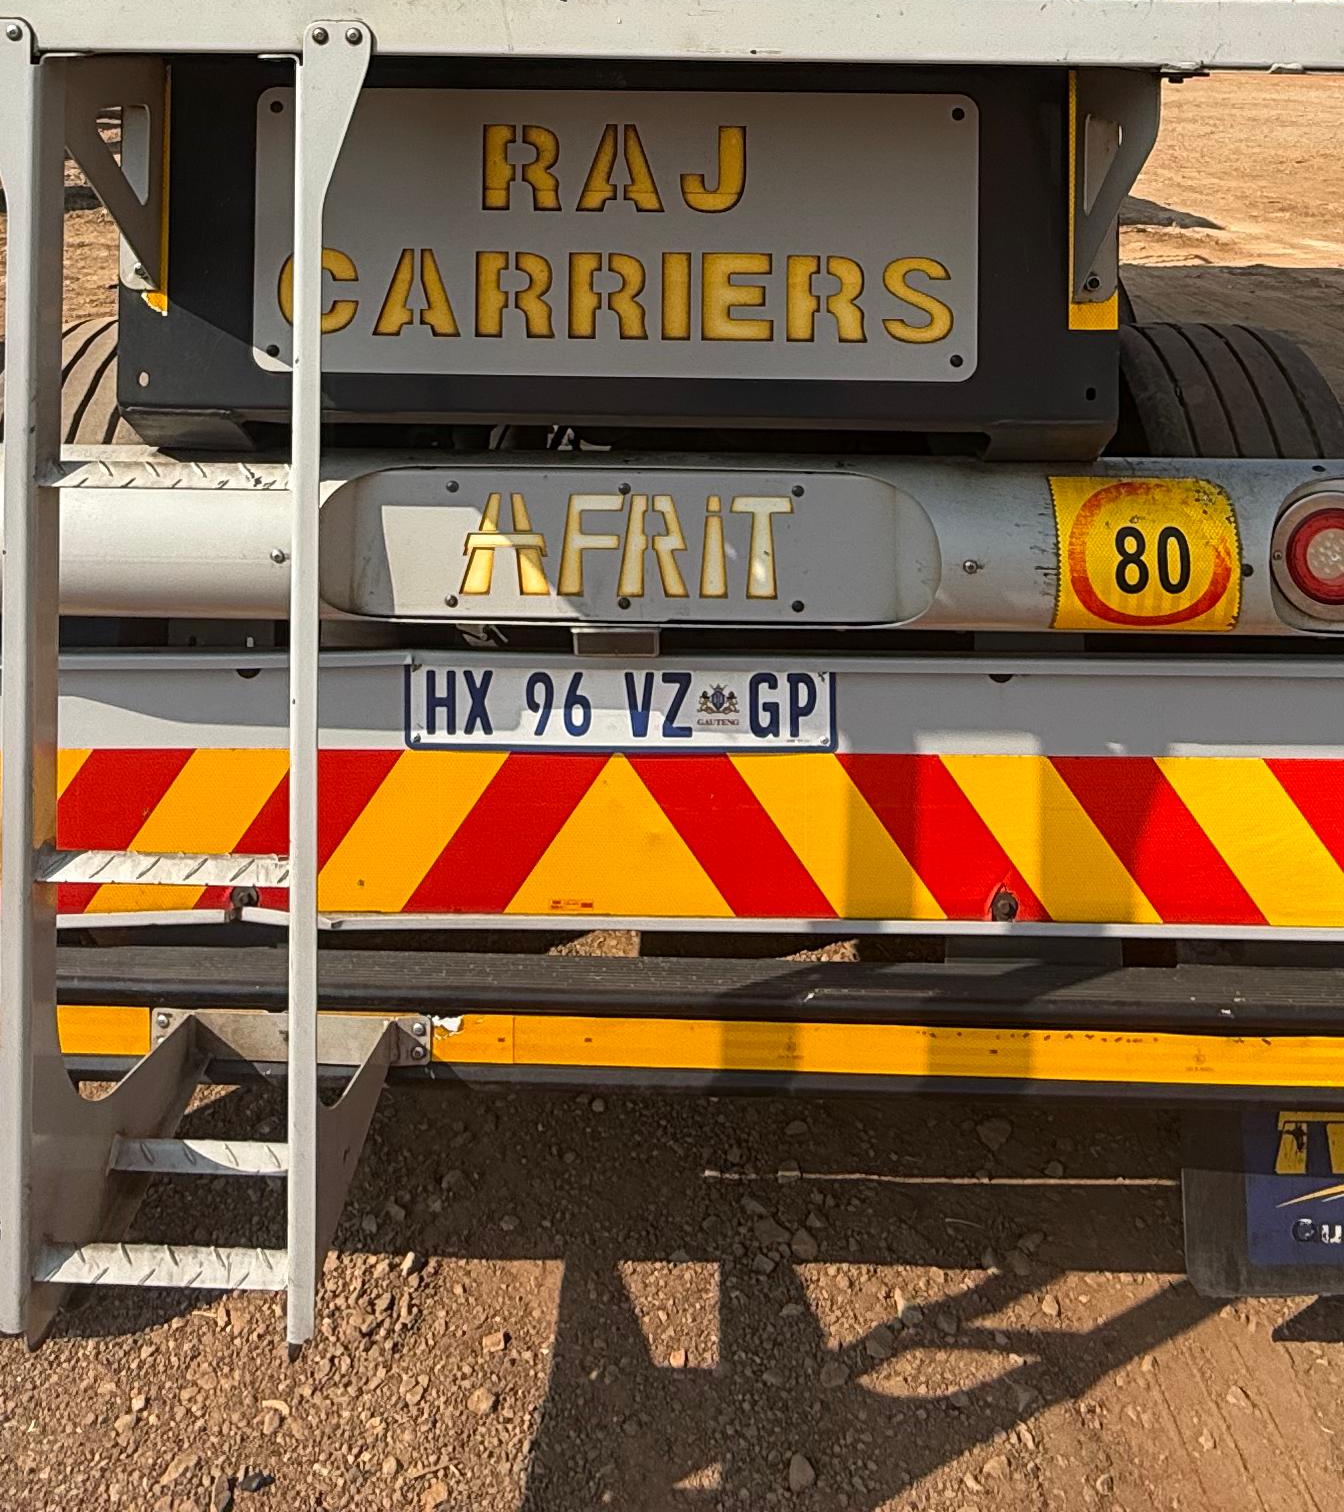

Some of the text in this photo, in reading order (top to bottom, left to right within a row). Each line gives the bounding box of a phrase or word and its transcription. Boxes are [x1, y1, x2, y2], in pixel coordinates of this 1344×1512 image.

[481, 123, 747, 213] RAJ
[278, 247, 954, 343] CARRIERS
[1115, 525, 1191, 594] 80
[426, 669, 817, 738] HX 96 VZ GP
[696, 718, 740, 726] GAUTENG
